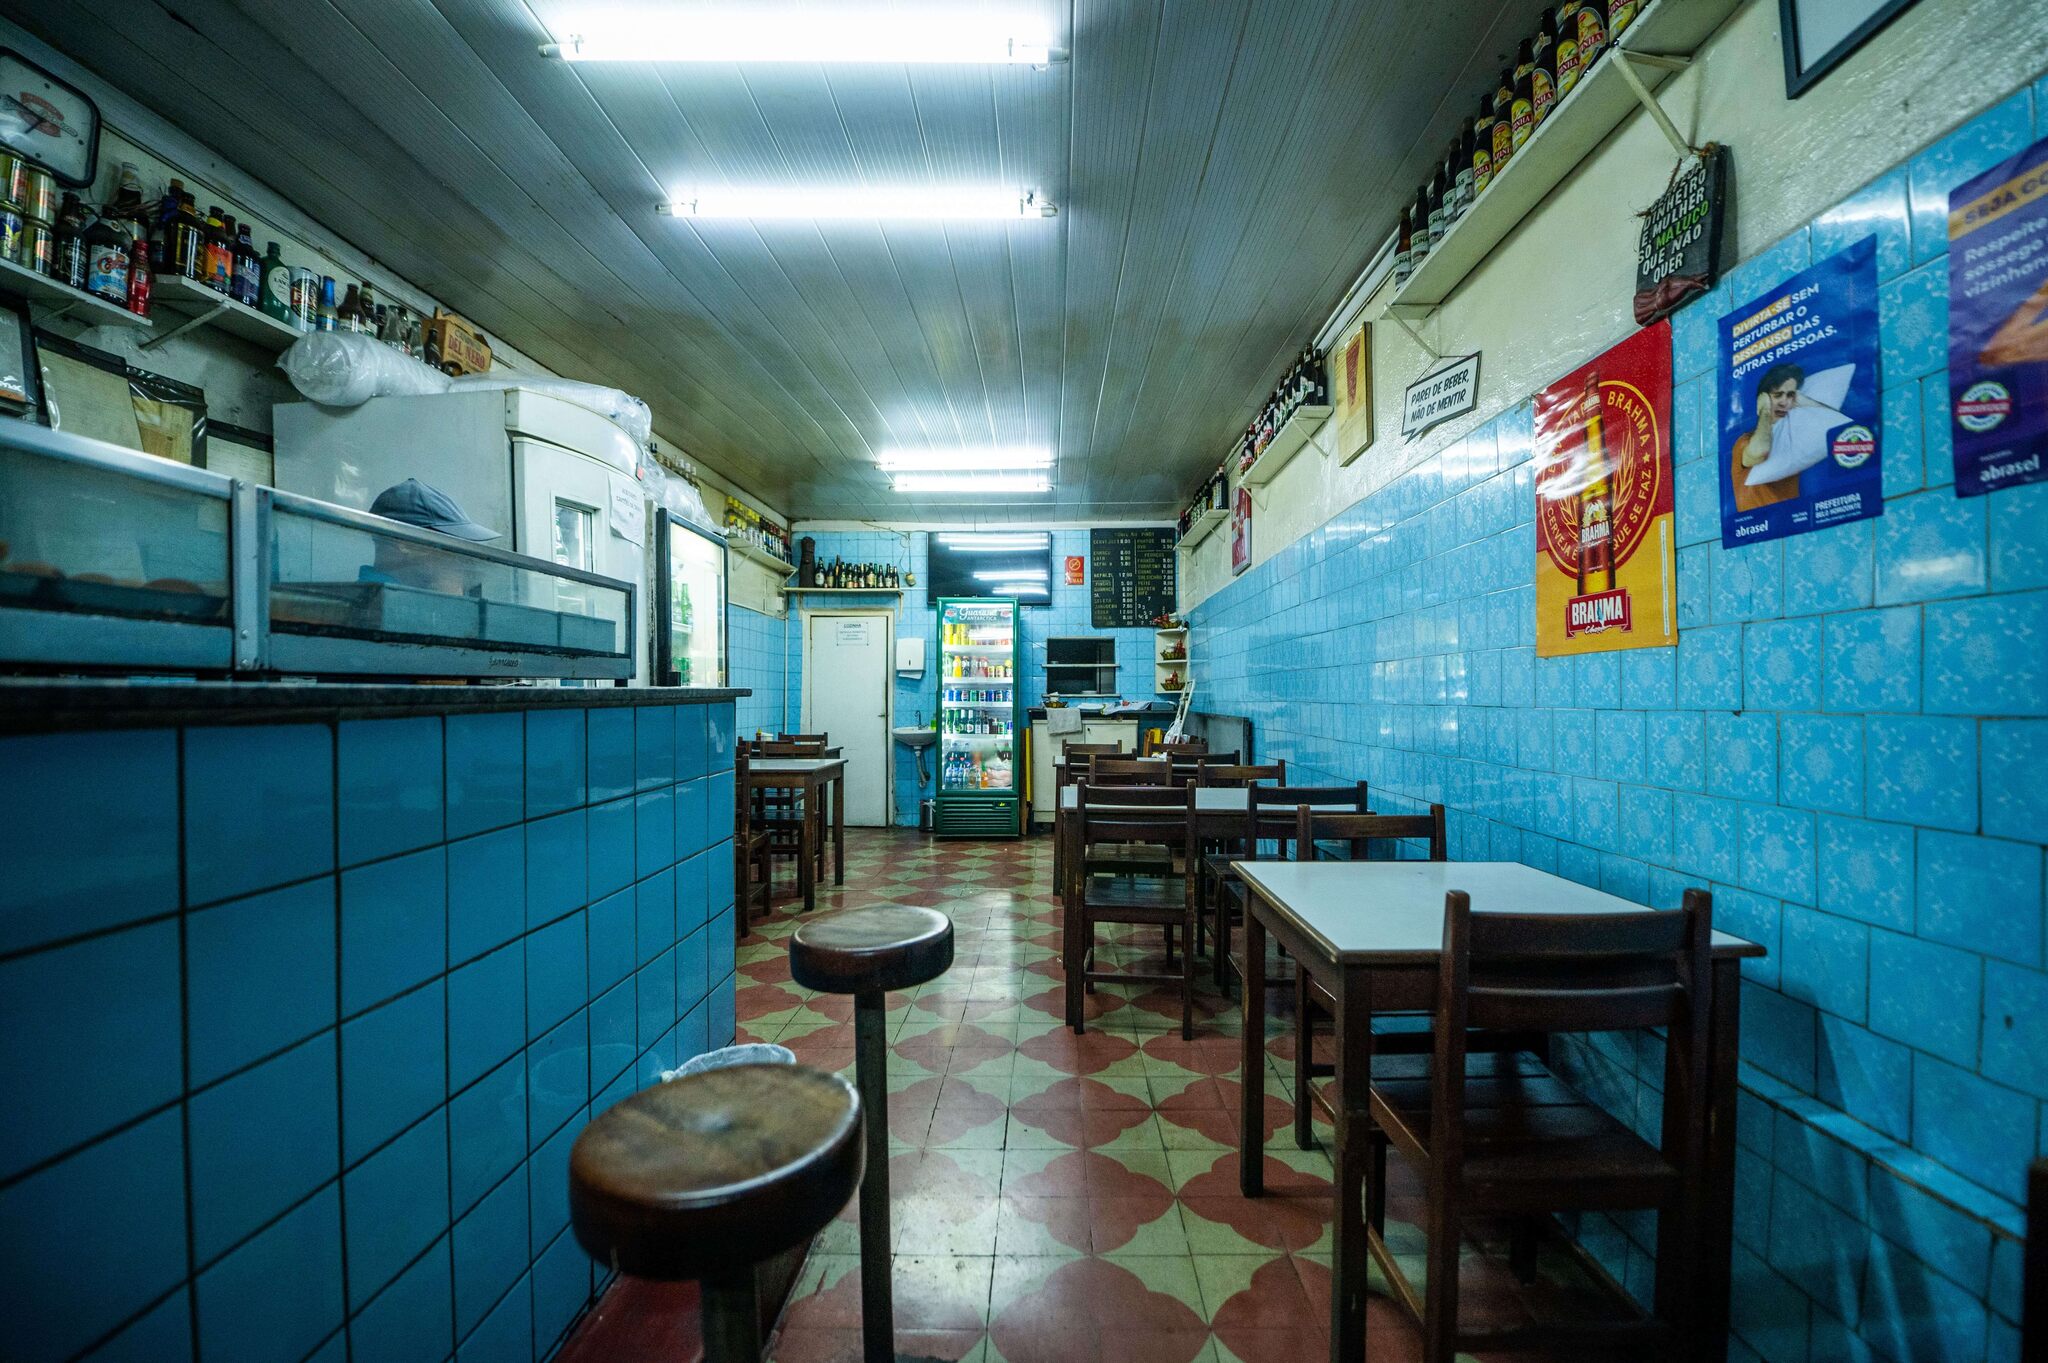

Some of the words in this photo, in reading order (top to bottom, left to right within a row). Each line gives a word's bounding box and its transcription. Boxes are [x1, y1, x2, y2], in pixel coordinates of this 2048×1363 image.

[1641, 232, 1649, 247] E
[1652, 187, 1705, 238] MULHER
[1643, 169, 1706, 232] DINHEIRO
[1656, 200, 1709, 249] MALUCO
[1965, 217, 2047, 262] Respeite
[1643, 247, 1666, 275] QUE
[1653, 252, 1684, 283] QUER
[1964, 239, 2044, 280] sossego
[1733, 297, 1791, 338] DIVIRTA-SE
[1792, 283, 1819, 304] SEM
[1733, 312, 1794, 351] PERTURBAR
[1796, 306, 1807, 317] O
[1732, 352, 1774, 379] OUTRAS
[1776, 325, 1838, 358] PESSOAS.
[1733, 328, 1792, 367] DESCANSO
[1793, 315, 1820, 335] DAS
[1411, 387, 1431, 406] PAREI
[1432, 381, 1443, 397] DE
[1444, 368, 1469, 391] BEBER,
[1411, 405, 1425, 422] NÃO
[1426, 401, 1437, 416] DE
[1437, 388, 1467, 412] MENTIR
[1607, 390, 1651, 447] BRAHMA
[1980, 454, 2039, 482] abrasel
[1547, 507, 1570, 558] CERVEJA
[1629, 503, 1643, 524] SE
[1638, 469, 1652, 501] FAZ
[1581, 520, 1610, 544] BRAHMA
[1735, 519, 1769, 538] abrasel
